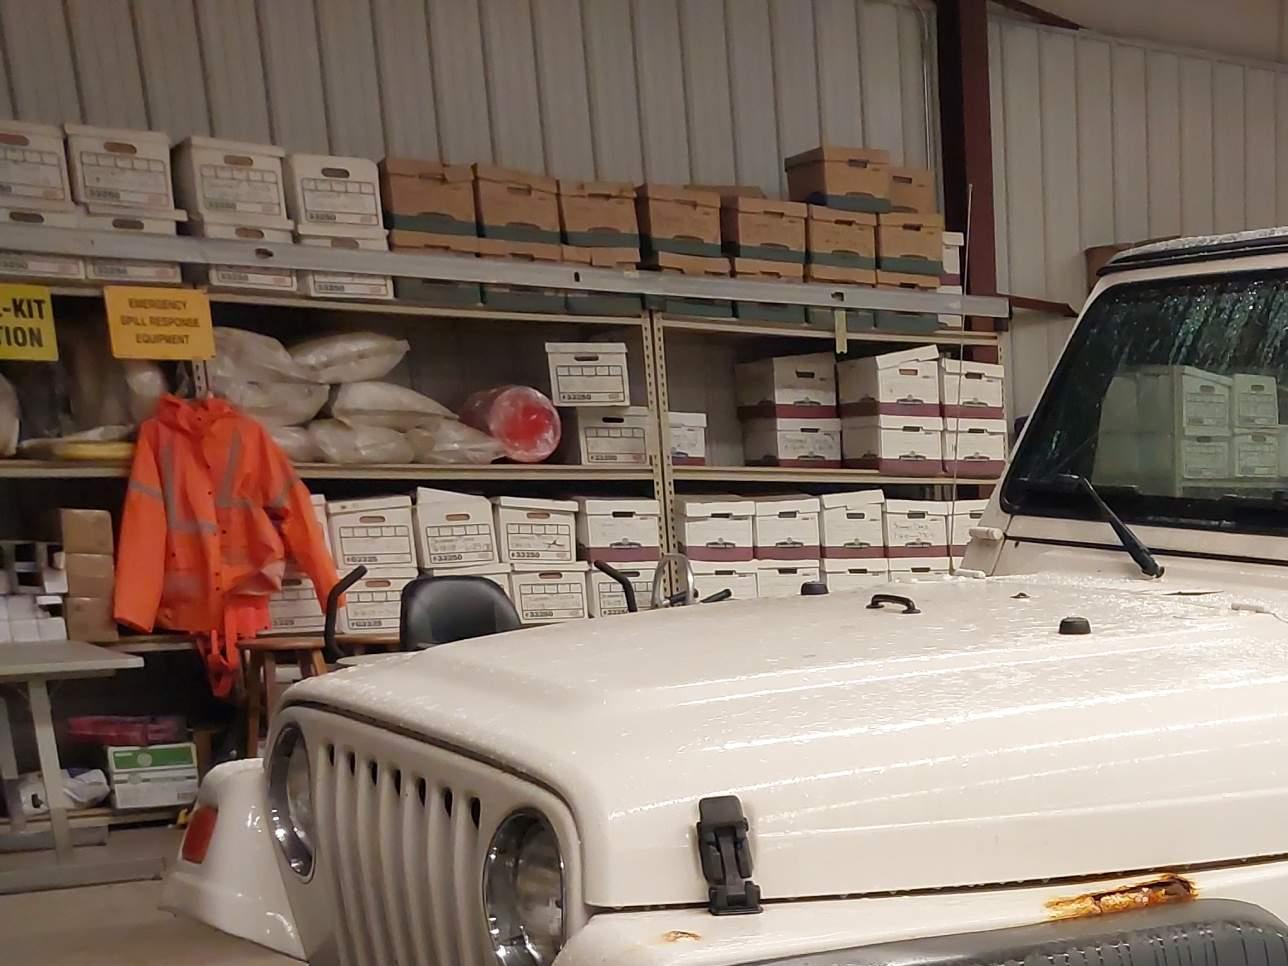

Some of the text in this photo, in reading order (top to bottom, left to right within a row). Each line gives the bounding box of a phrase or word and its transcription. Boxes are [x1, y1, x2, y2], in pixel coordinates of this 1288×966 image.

[0, 298, 46, 320] -KIT
[129, 298, 188, 310] EMERGENCY
[120, 315, 200, 328] SPILL RESPONSE
[136, 333, 190, 345] EQUIPMENT
